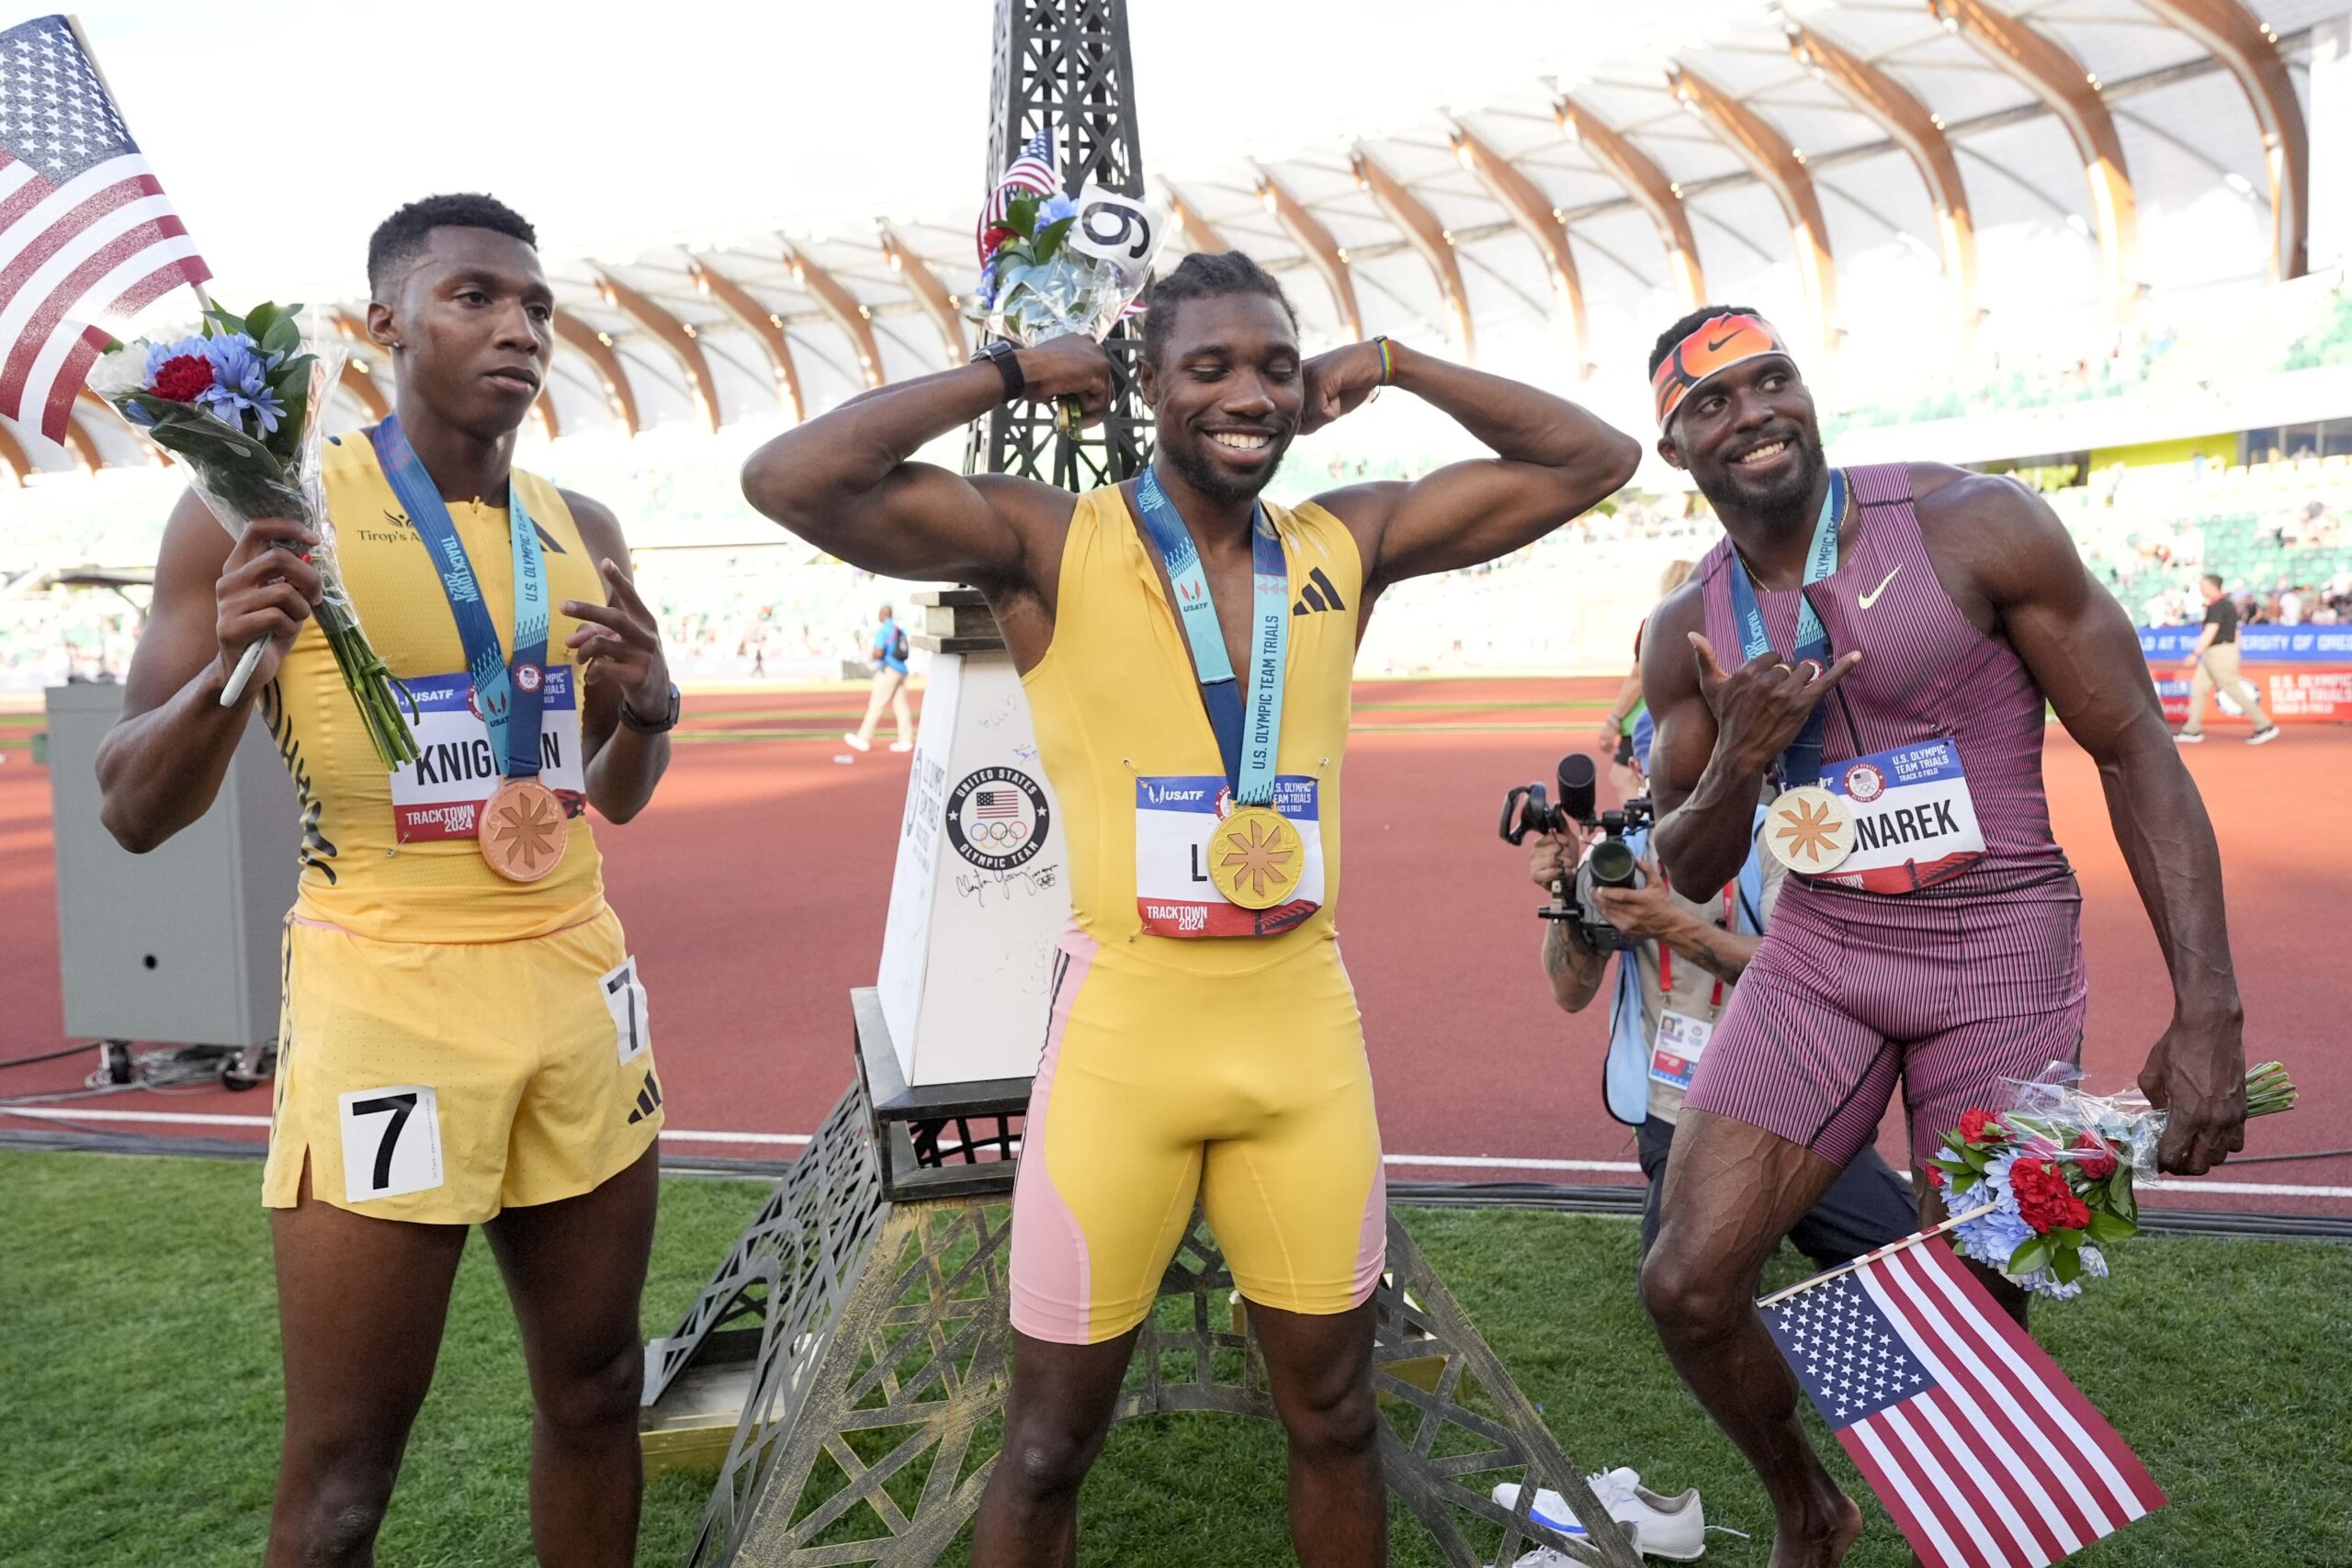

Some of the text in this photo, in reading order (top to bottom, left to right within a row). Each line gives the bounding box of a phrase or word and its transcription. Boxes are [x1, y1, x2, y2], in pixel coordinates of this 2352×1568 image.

[356, 529, 421, 544] Tirop's A
[519, 533, 537, 579] OLYMPIC
[1815, 536, 1836, 579] OLYMPIC
[441, 535, 479, 604] TRACKTOWN
[444, 572, 465, 602] 2024
[525, 581, 538, 603] U.S.
[1183, 602, 1208, 613] USATF
[1747, 607, 1770, 654] TRACKTOW
[1746, 644, 1757, 660] 202
[545, 672, 564, 683] MPIC
[413, 689, 454, 703] USATF
[544, 683, 565, 694] RIALS
[1252, 615, 1279, 770] U.S. OLYMPIC TEAM TRIALS
[490, 716, 510, 728] USAT
[415, 731, 561, 786] KNIGN
[1893, 744, 1946, 765] U.S. OLYMPIC
[1894, 754, 1950, 775] TEAM TRIALS
[956, 769, 993, 797] UNITED
[998, 768, 1037, 795] STATES
[1898, 773, 1917, 783] TRACK
[1923, 767, 1939, 777] FIELD
[1166, 790, 1204, 801] USATF
[1273, 782, 1311, 793] .S. OLYMPIC
[1273, 794, 1311, 804] EAM TRIALS
[406, 804, 475, 826] TRACKTOWN
[444, 817, 473, 833] 2024
[1850, 798, 1960, 853] NAREK
[959, 842, 1006, 869] OLYMPIC
[1012, 840, 1039, 864] TEAM
[1147, 906, 1208, 919] TRACKTOWN
[1178, 918, 1204, 931] 2024
[607, 967, 639, 1052] 7
[352, 1092, 417, 1190] 7
